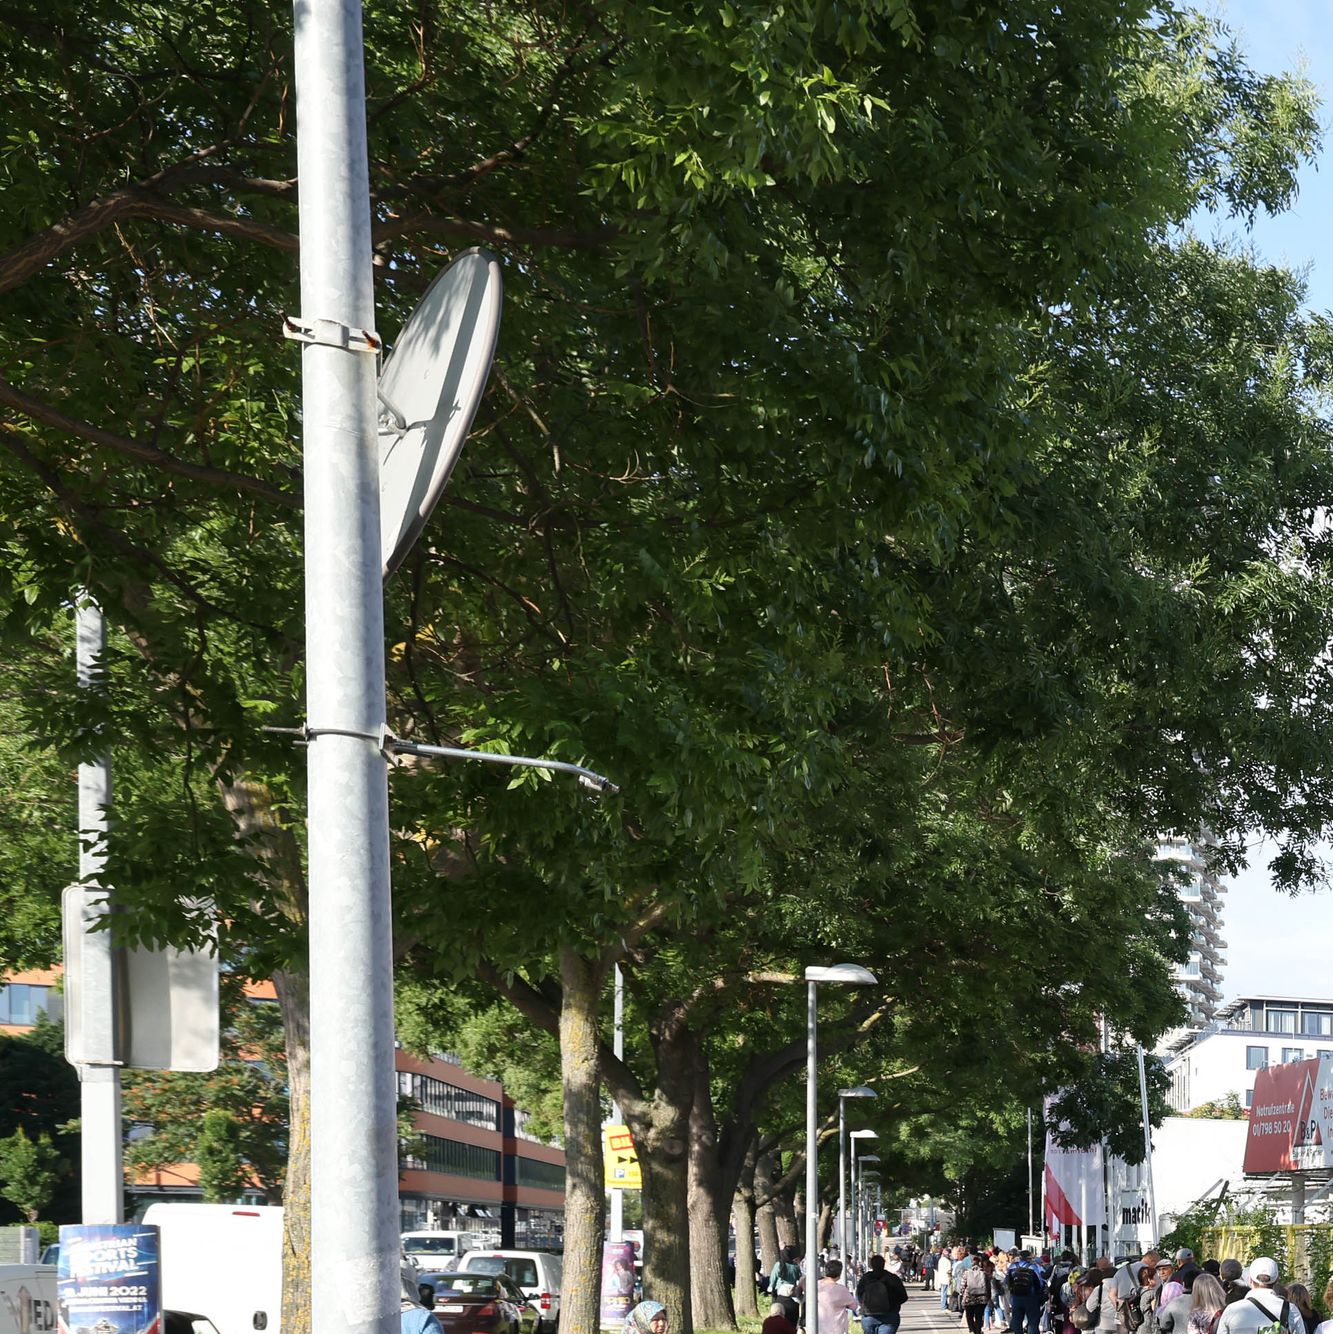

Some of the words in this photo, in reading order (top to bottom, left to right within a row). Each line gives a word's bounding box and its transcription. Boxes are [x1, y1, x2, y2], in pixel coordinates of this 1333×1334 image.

[1256, 1103, 1295, 1117] Notrufzentrale
[1253, 1121, 1273, 1136] 01/798
[1274, 1121, 1281, 1134] 50
[1283, 1120, 1291, 1133] 20
[1122, 1198, 1151, 1225] matik
[109, 1285, 147, 1296] 2022
